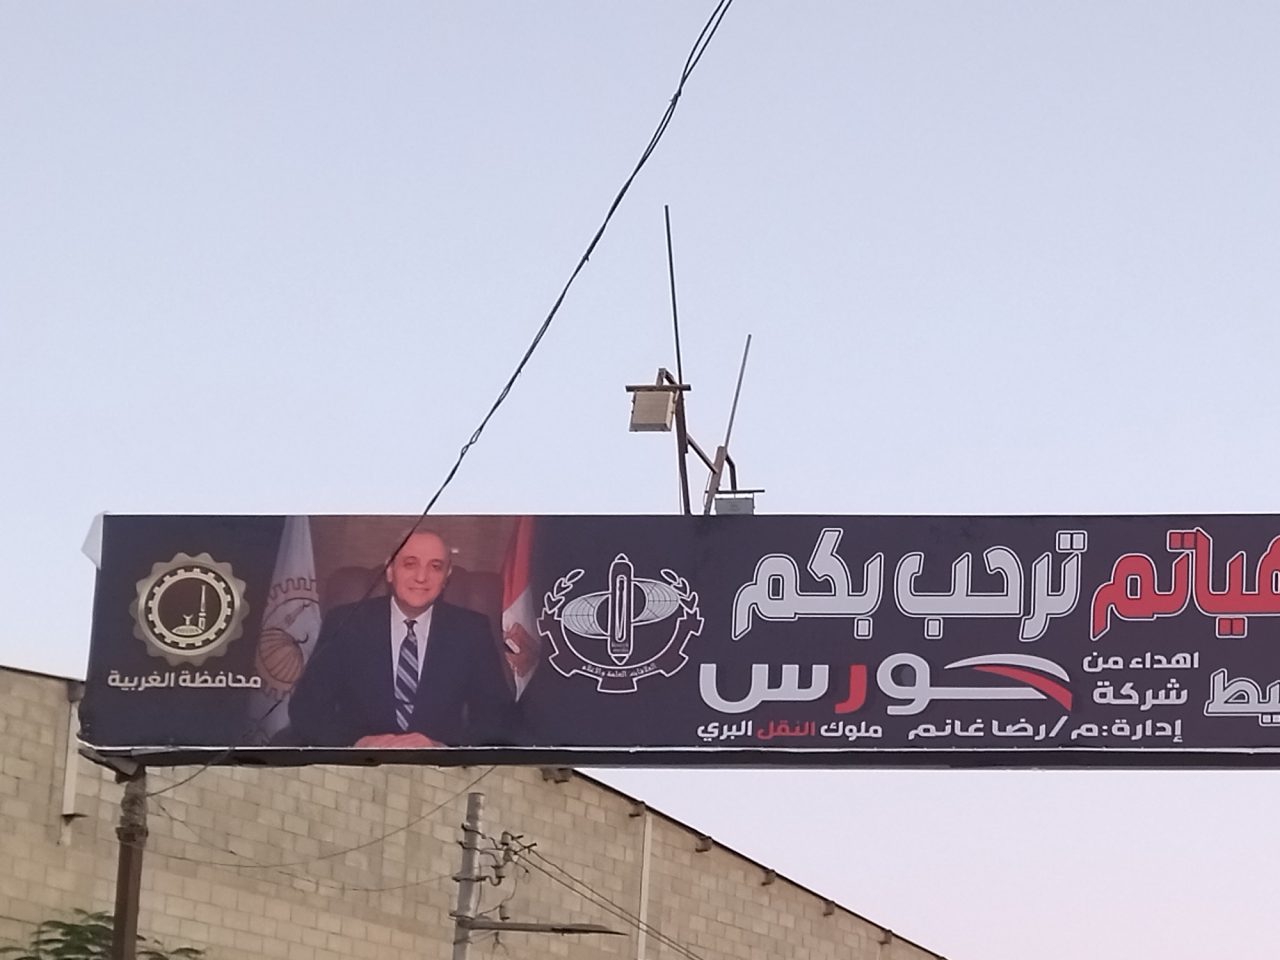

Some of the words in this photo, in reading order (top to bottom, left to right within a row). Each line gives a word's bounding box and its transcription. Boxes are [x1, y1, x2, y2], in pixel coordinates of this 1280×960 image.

[732, 527, 884, 640] بكم
[893, 530, 1088, 642] ترحب
[1082, 651, 1124, 673] من
[1128, 652, 1200, 669] اهداء
[107, 669, 175, 691] الغربية
[178, 669, 262, 688] محافظة
[1092, 678, 1189, 710] شركة
[696, 720, 753, 741] البري
[757, 720, 815, 740] النقل
[820, 720, 883, 740] ملوك
[908, 719, 984, 740] غانم
